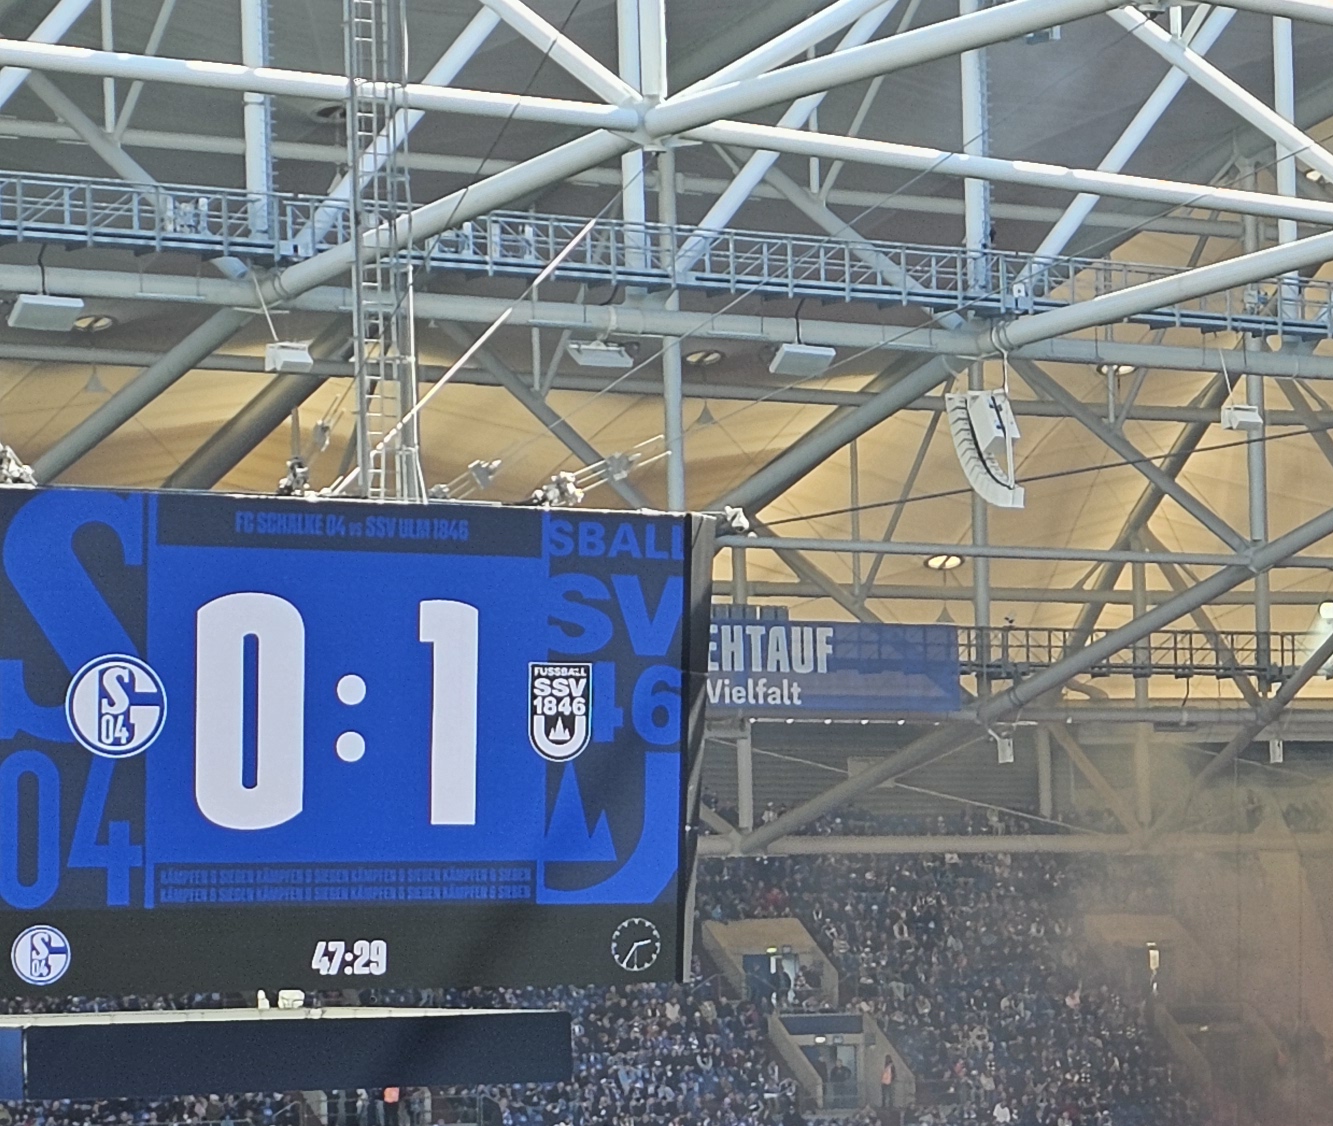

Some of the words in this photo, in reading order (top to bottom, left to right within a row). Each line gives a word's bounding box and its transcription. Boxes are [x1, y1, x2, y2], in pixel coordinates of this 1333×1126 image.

[235, 511, 254, 533] FC
[257, 512, 322, 536] SCHALKE
[326, 514, 346, 537] 04
[365, 515, 396, 538] SSV
[399, 517, 430, 540] ULM
[433, 518, 468, 541] 1846
[534, 666, 587, 677] FUSSBALL
[533, 677, 587, 697] SSV
[707, 678, 802, 706] Vielfalt
[533, 697, 586, 716] 1846
[311, 939, 387, 976] 47:29
